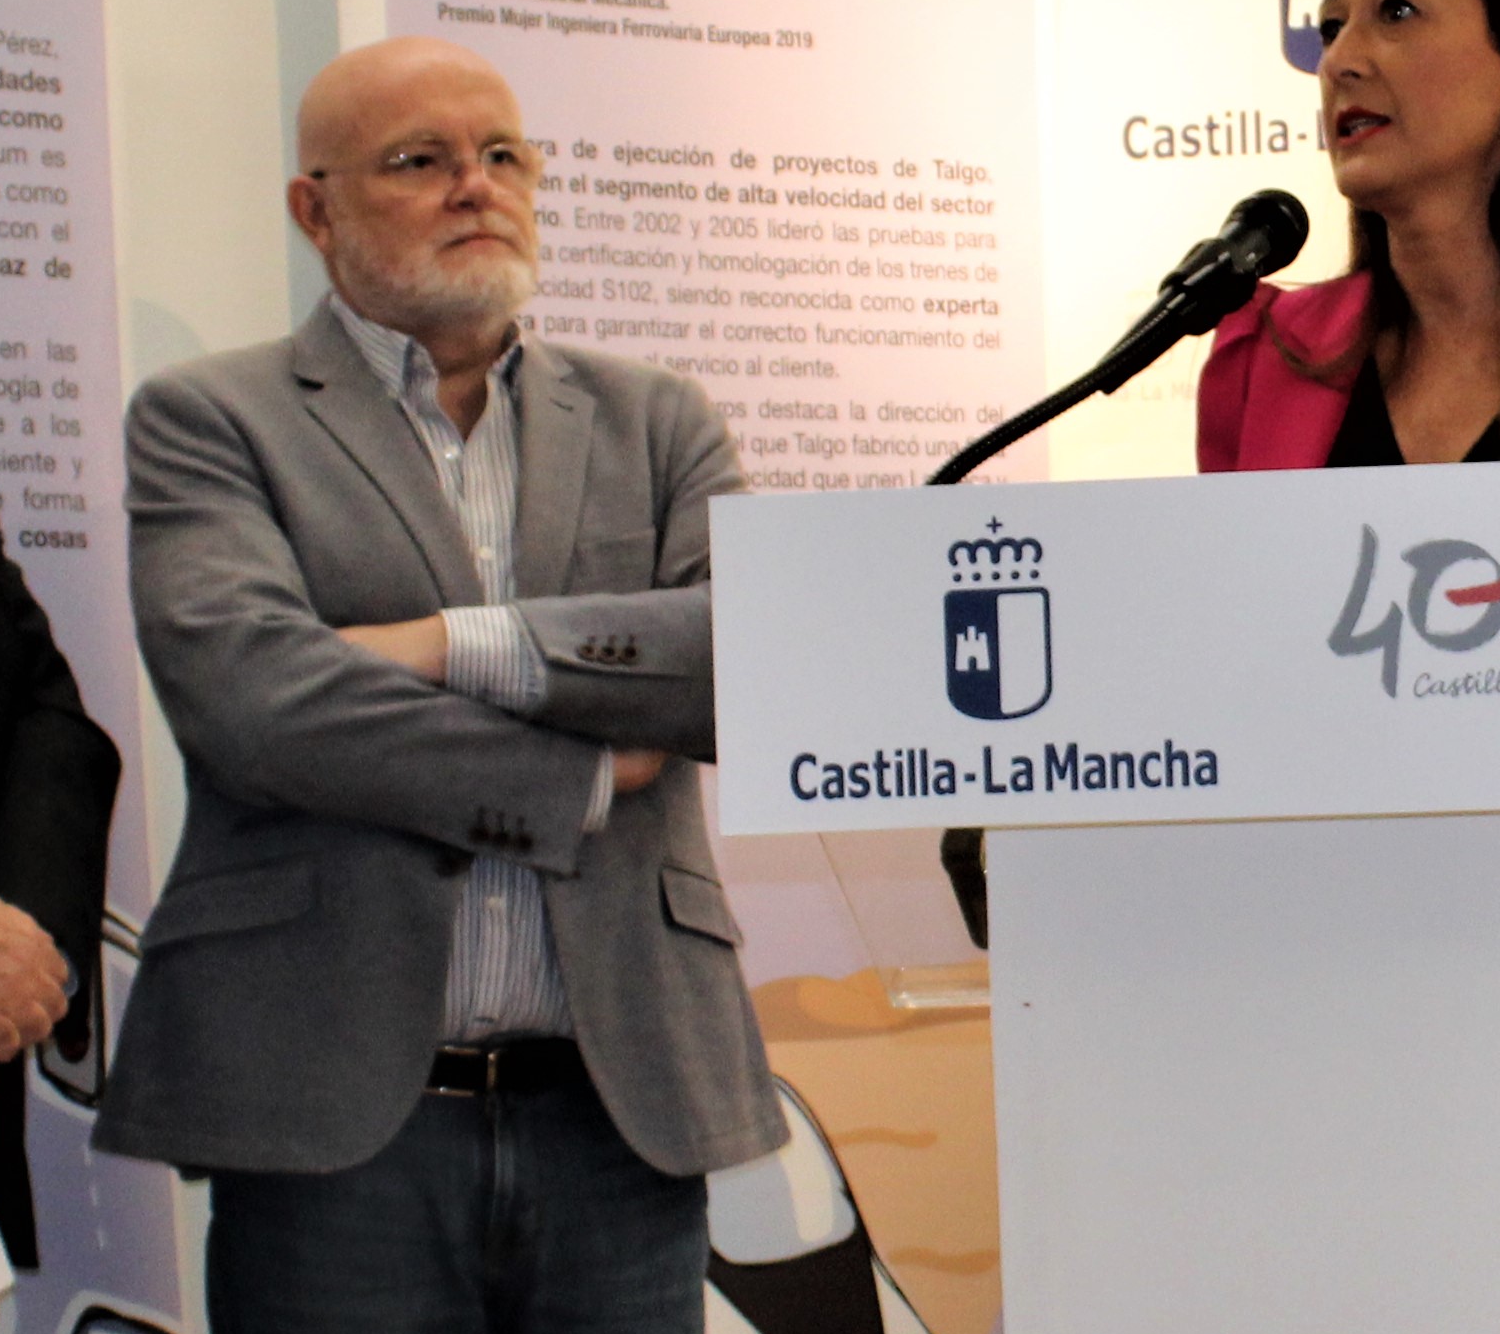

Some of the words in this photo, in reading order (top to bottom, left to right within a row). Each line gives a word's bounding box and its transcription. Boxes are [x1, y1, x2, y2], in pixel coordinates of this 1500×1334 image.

[437, 2, 495, 24] Premio
[501, 9, 541, 29] Mujer
[548, 15, 618, 35] Ingeniera
[623, 19, 703, 42] Ferroviaria
[708, 25, 771, 48] Europea
[777, 30, 814, 49] 2019
[1121, 110, 1329, 160] Castilla-
[614, 141, 715, 170] ejecución
[730, 149, 757, 170] de
[773, 152, 877, 180] proyectos
[594, 179, 698, 201] segmento
[739, 185, 777, 205] alta
[785, 188, 886, 210] velocidad
[894, 193, 923, 211] del
[931, 198, 994, 214] sector
[634, 211, 681, 235] 2002
[709, 215, 758, 239] 2005
[923, 298, 999, 317] experta
[19, 530, 88, 549] cosas
[1045, 740, 1218, 792] Mancha
